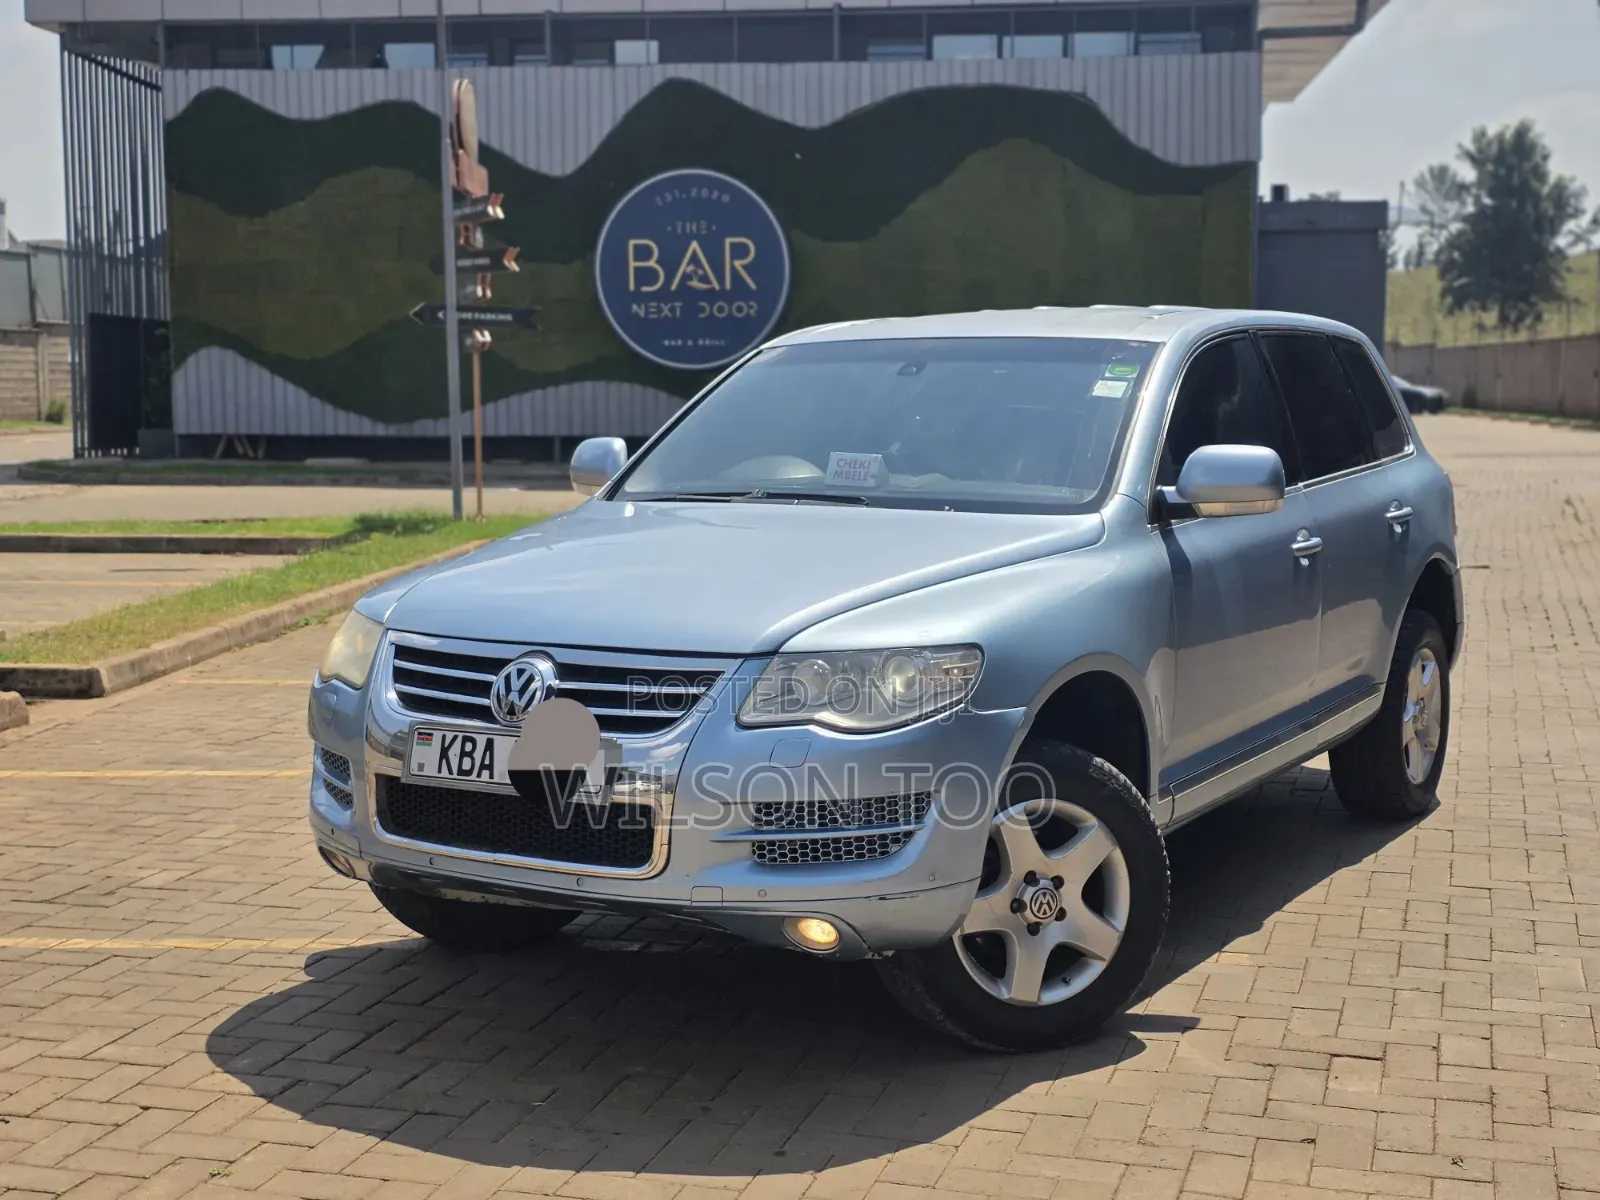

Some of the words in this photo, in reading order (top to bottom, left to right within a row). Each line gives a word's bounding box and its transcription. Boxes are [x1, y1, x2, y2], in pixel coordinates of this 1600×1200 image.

[675, 221, 708, 235] THE
[628, 237, 757, 292] BAR
[474, 312, 513, 322] PARKING
[631, 302, 683, 318] NEXT
[697, 301, 758, 318] DOOR
[837, 459, 871, 469] CHEKI
[437, 733, 495, 780] KBA
